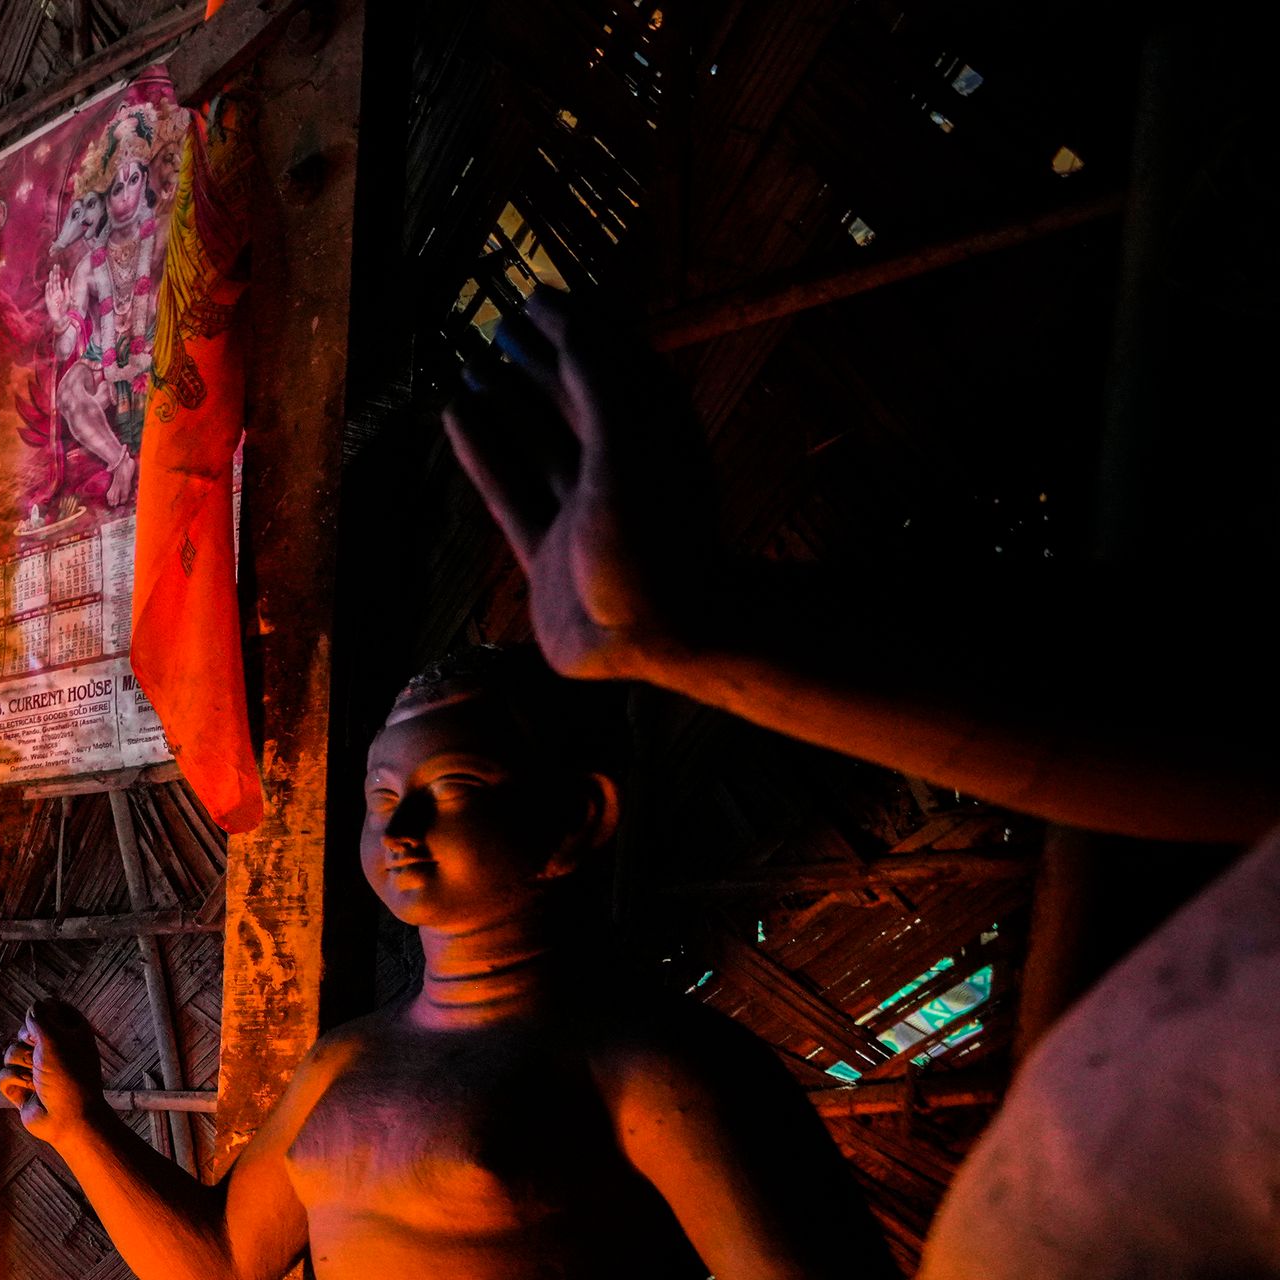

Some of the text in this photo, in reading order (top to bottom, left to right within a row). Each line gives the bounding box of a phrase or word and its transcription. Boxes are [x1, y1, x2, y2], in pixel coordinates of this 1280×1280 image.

[9, 690, 64, 714] CURRENT
[68, 679, 113, 702] HOUSE
[0, 715, 42, 731] ELECTRICALS
[43, 710, 68, 723] GOODS
[69, 706, 88, 717] SOLD
[90, 703, 109, 714] HERE
